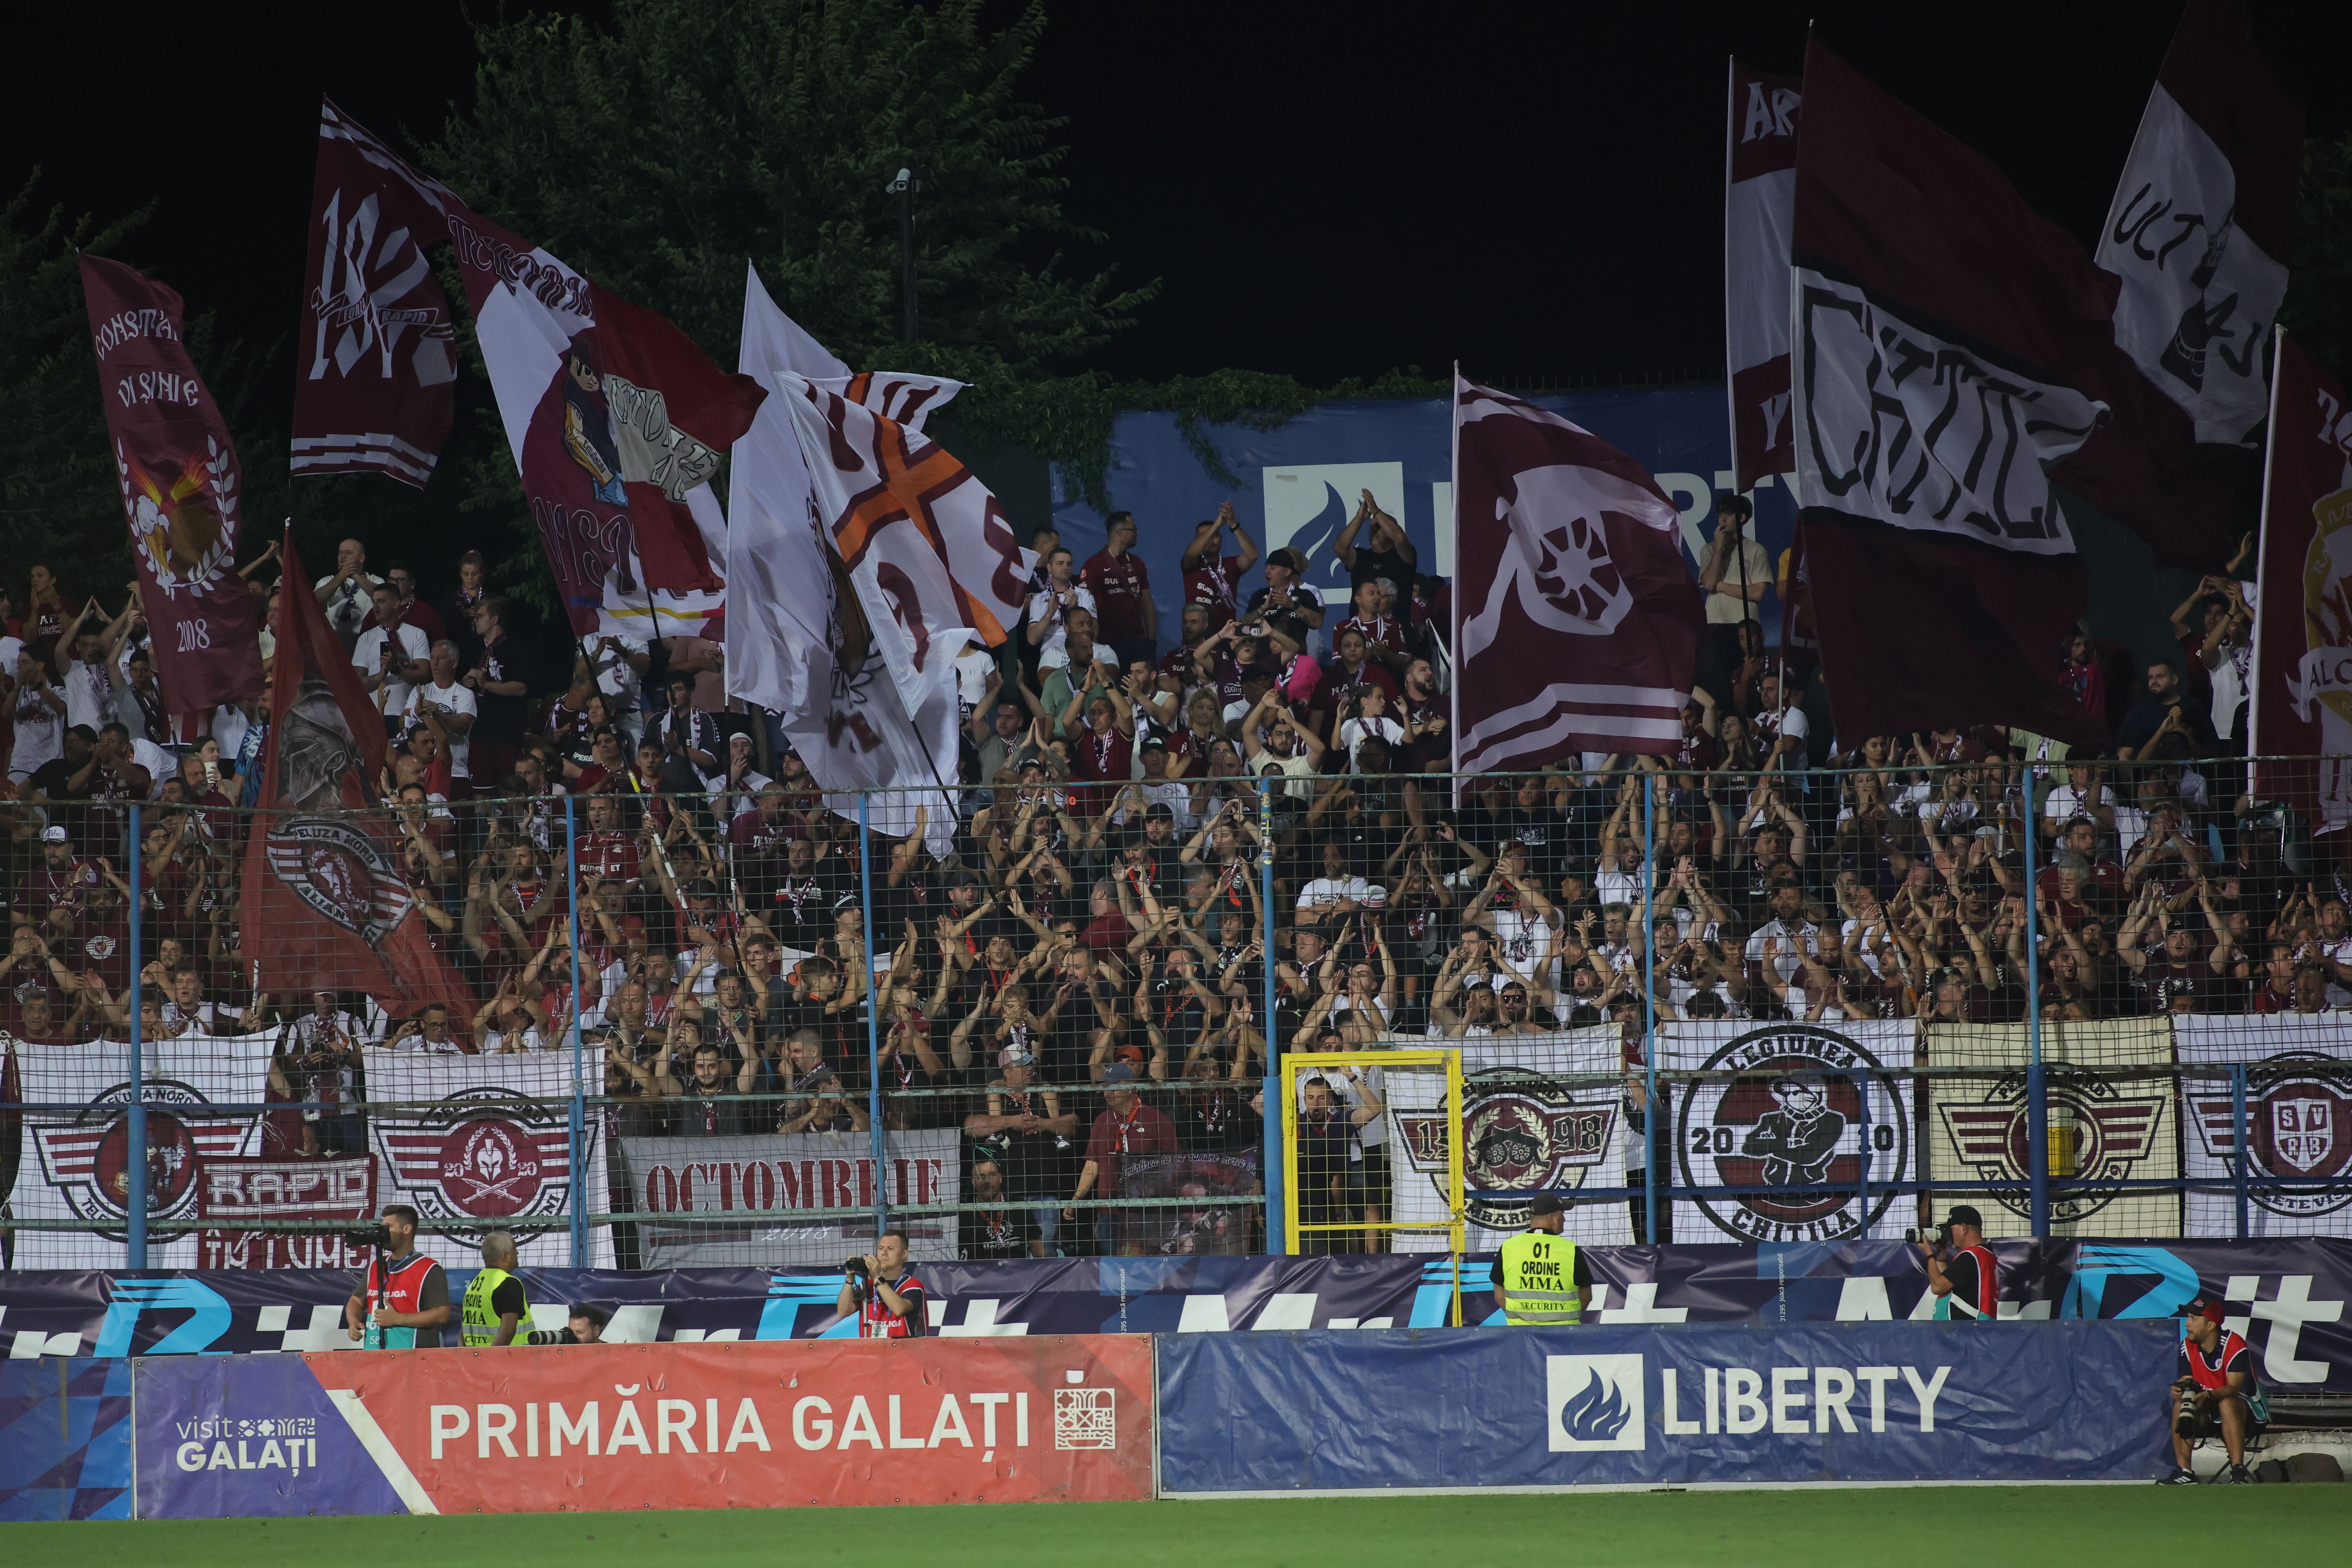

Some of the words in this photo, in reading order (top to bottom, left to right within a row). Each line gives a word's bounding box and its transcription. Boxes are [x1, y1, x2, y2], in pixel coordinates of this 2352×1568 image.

[344, 297, 366, 321] FORZA
[381, 311, 428, 323] RAPID
[176, 618, 211, 653] 2008
[1726, 1035, 1857, 1070] LEGIUNEA
[2282, 1109, 2293, 1127] S
[2311, 1107, 2324, 1125] V
[1552, 1114, 1603, 1154] 98
[1691, 1127, 1733, 1154] 20
[2288, 1138, 2298, 1156] R
[2310, 1136, 2320, 1155] B
[444, 1163, 464, 1177] 20
[517, 1161, 537, 1176] 20
[644, 1158, 944, 1213] OCTOMBRIE
[760, 1222, 834, 1243] 2018
[1731, 1209, 1858, 1242] CHITILA
[1533, 1242, 1550, 1259] 01
[1522, 1261, 1560, 1276] ORDINE
[1777, 1253, 1786, 1285] responsabil
[471, 1276, 485, 1291] 03
[1519, 1276, 1564, 1290] MMA
[1521, 1302, 1566, 1310] SECURITY
[1663, 1366, 1952, 1435] LIBERTY
[176, 1414, 234, 1439] visit
[430, 1383, 771, 1459] PRIMĂRIA
[791, 1392, 1029, 1463] GALAȚI
[176, 1438, 316, 1478] GALAȚI
